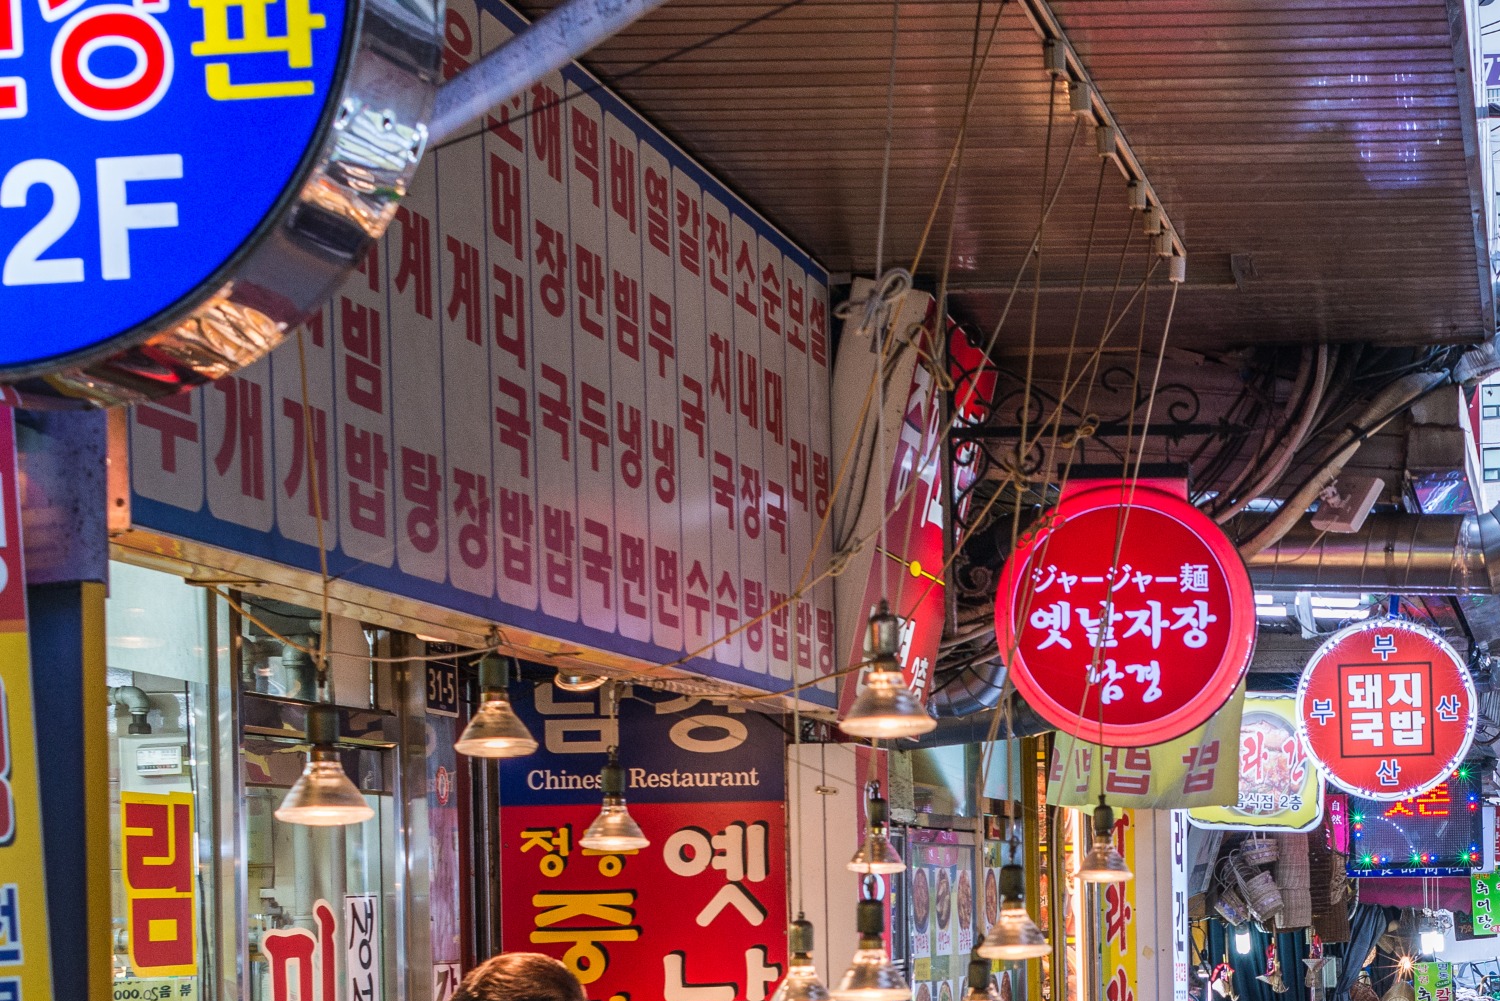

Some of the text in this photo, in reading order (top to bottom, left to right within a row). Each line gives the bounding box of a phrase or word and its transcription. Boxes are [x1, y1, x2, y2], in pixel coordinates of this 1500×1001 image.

[3, 154, 183, 286] 2F
[532, 80, 574, 598] 해장국밥
[571, 105, 612, 610] 떡만두국
[609, 136, 646, 620] 비빔냉면
[644, 165, 680, 629] 열무냉면
[677, 187, 711, 637] 칼국수
[706, 212, 740, 645] 잔치국수
[735, 239, 766, 654] 소내장탕
[761, 262, 790, 662] 순대국밥
[787, 278, 812, 668] 보리밥
[428, 671, 457, 705] 31-5
[1030, 600, 1217, 651] 옛날자장
[1087, 660, 1163, 705] 남경
[1348, 673, 1423, 709] 돼지
[1351, 710, 1426, 748] 국밥
[527, 768, 760, 791] Chines Restaurant
[1280, 795, 1303, 811] 2층
[1477, 880, 1492, 929] 추어탕
